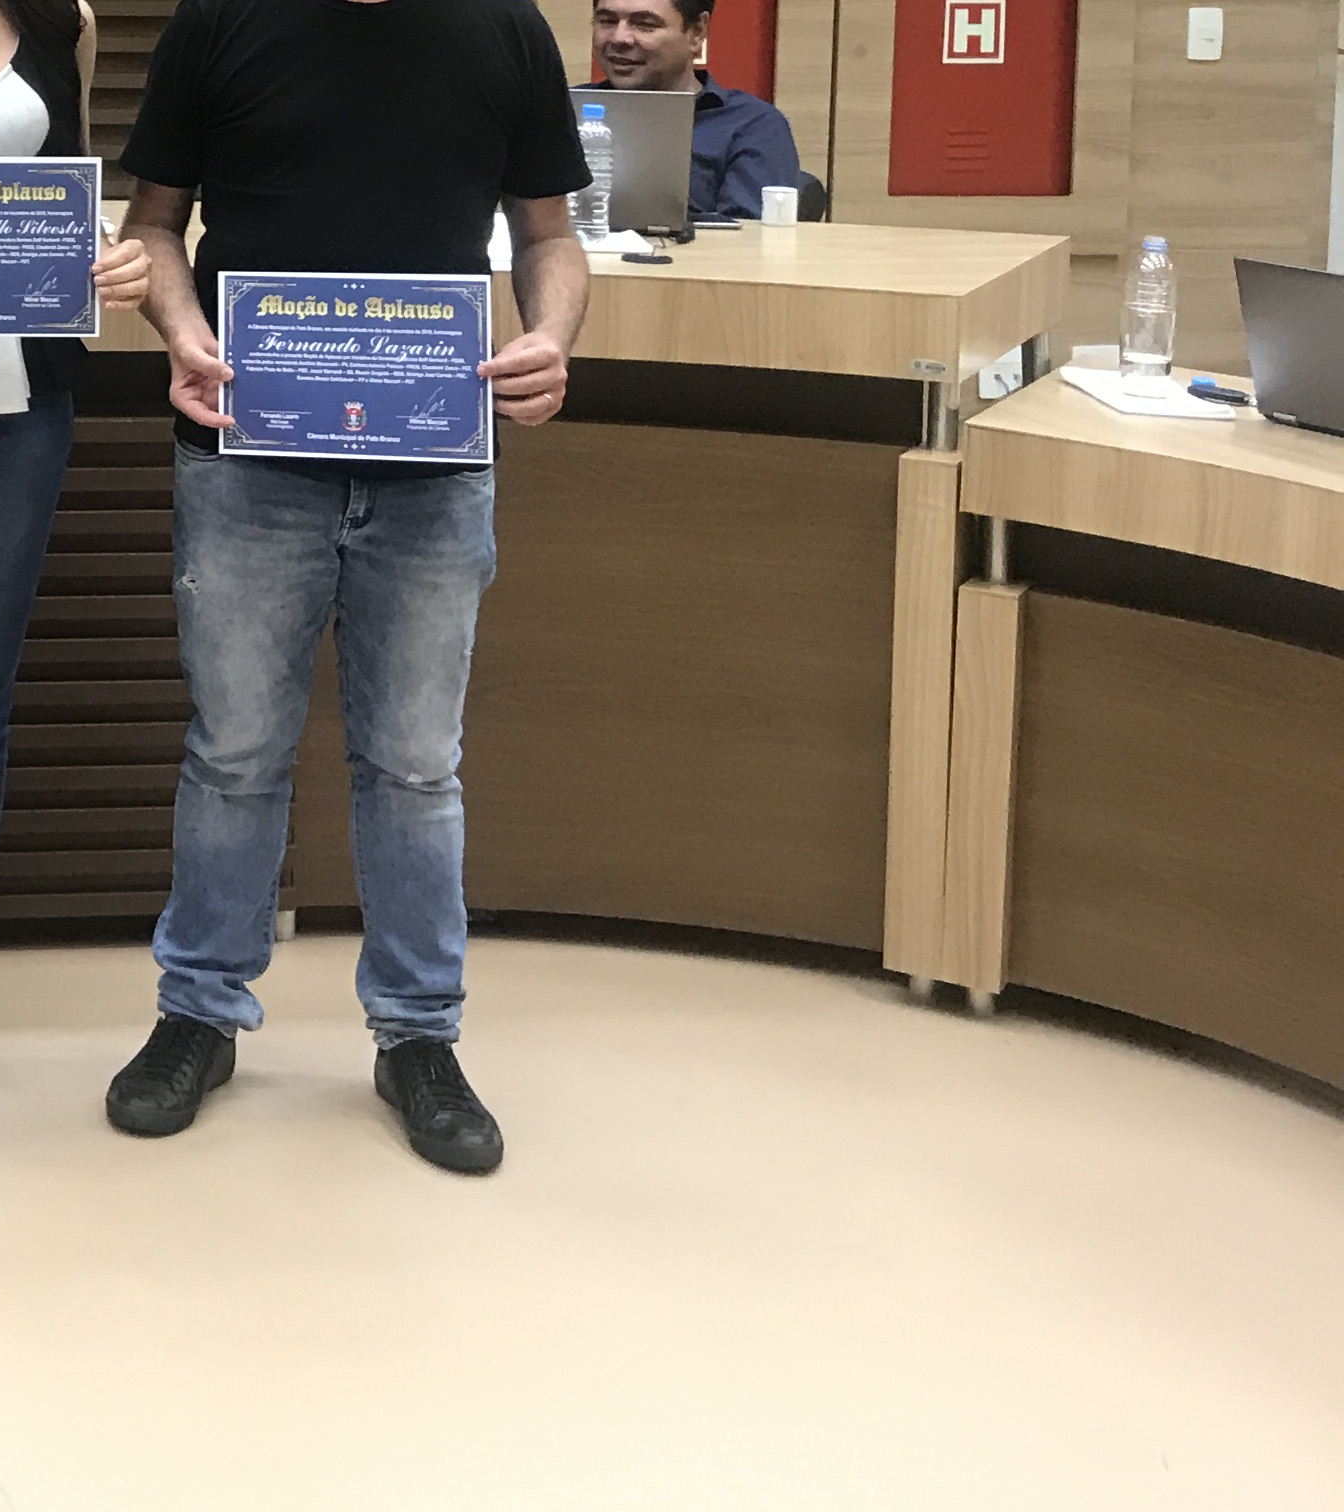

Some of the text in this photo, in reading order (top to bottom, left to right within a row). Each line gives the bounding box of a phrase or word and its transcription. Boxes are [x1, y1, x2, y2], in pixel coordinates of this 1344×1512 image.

[953, 8, 996, 54] H
[256, 294, 455, 323] Moção de Aplauso
[258, 331, 361, 355] Fernando
